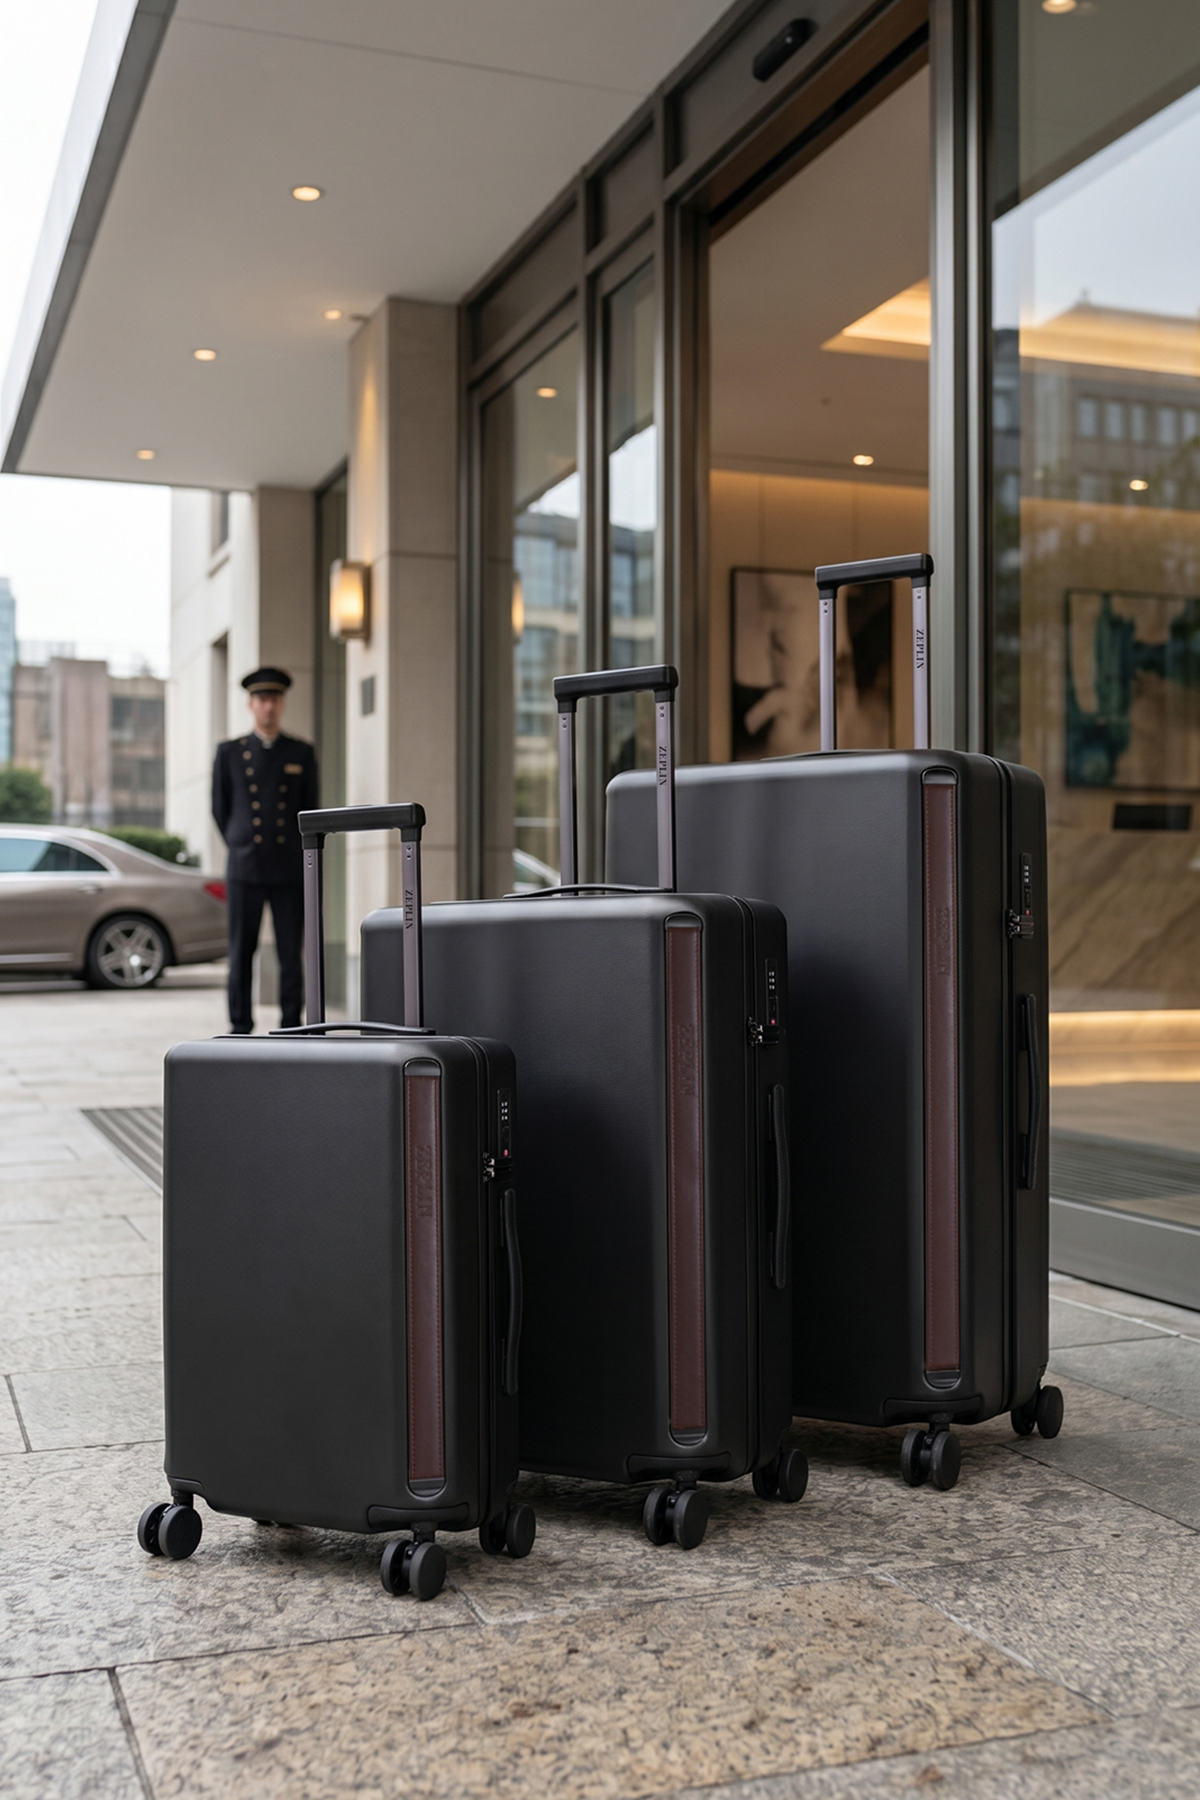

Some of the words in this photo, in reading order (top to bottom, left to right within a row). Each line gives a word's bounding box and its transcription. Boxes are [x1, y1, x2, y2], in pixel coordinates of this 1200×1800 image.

[916, 629, 924, 668] ZEPLIN
[659, 746, 667, 785] ZEPLIN
[405, 890, 413, 929] ZEPLIN
[678, 1024, 696, 1097] ZEPLIN
[416, 1145, 433, 1218] ZEPLIN
